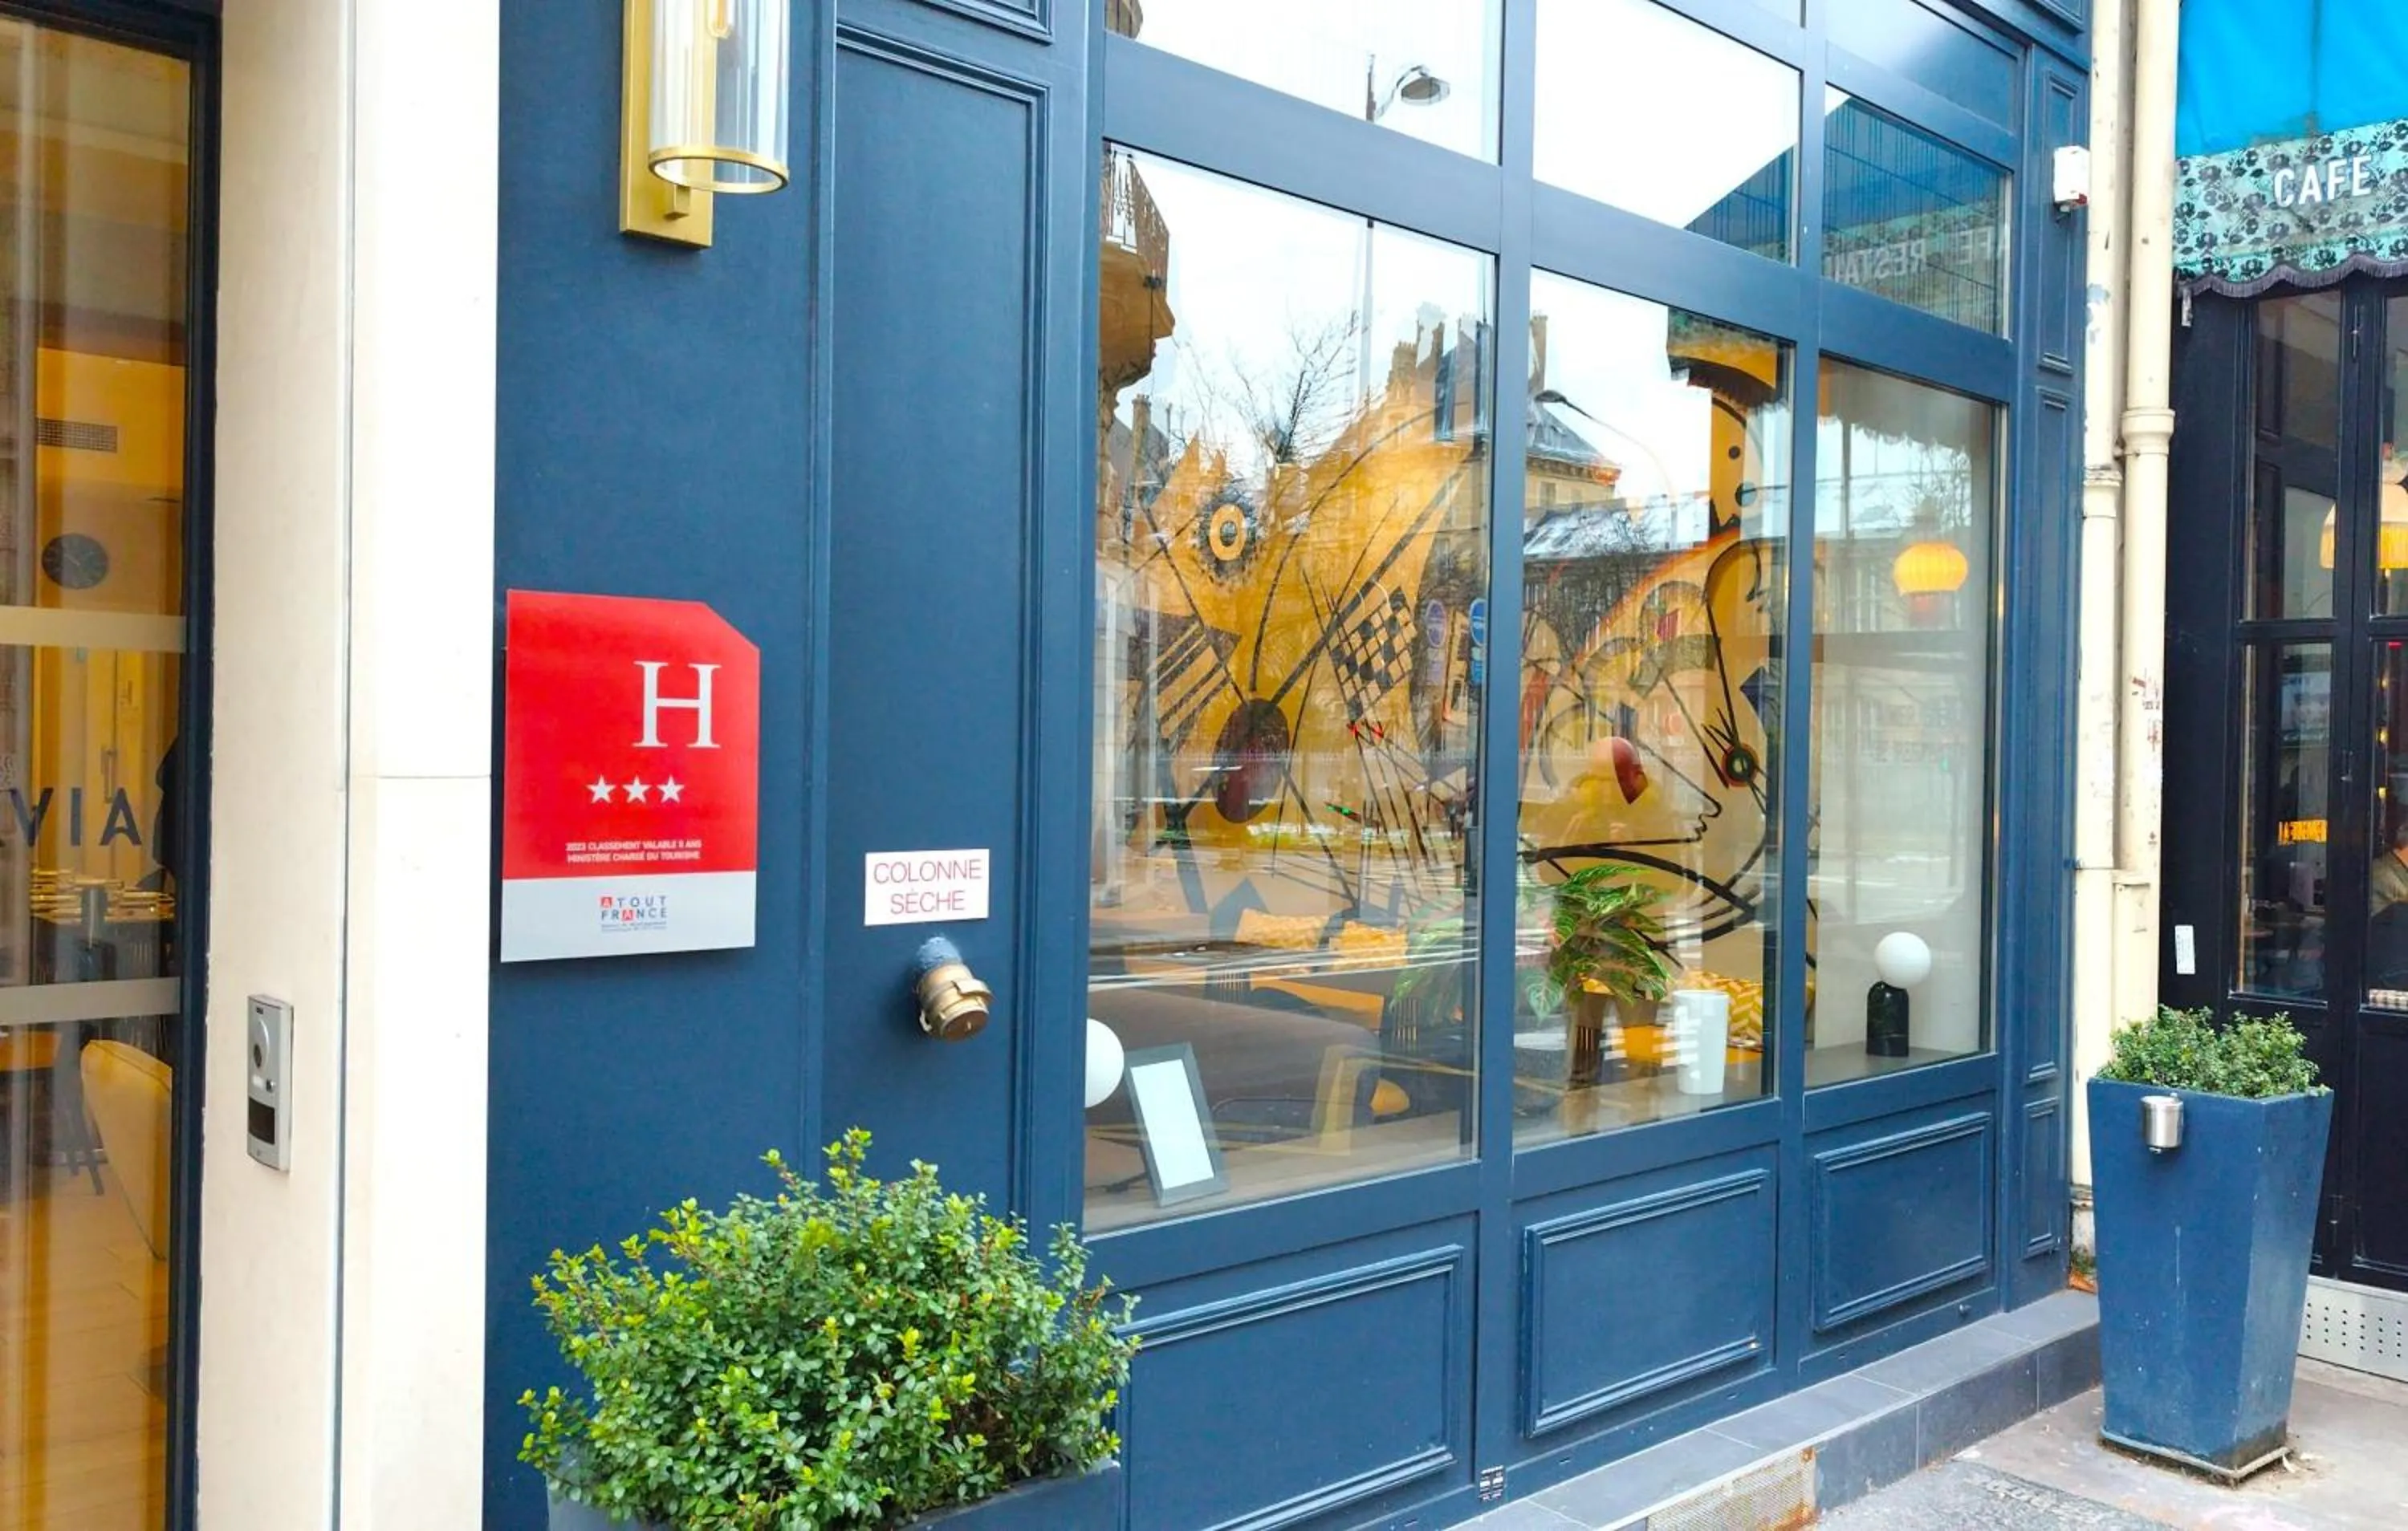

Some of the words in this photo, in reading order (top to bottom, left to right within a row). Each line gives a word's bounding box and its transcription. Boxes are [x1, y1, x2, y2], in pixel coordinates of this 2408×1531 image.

[2273, 146, 2372, 208] CAFÉ
[632, 660, 722, 748] H
[873, 859, 982, 884] COLONNE
[600, 895, 667, 908] ATOUT
[600, 908, 668, 920] FRANCE
